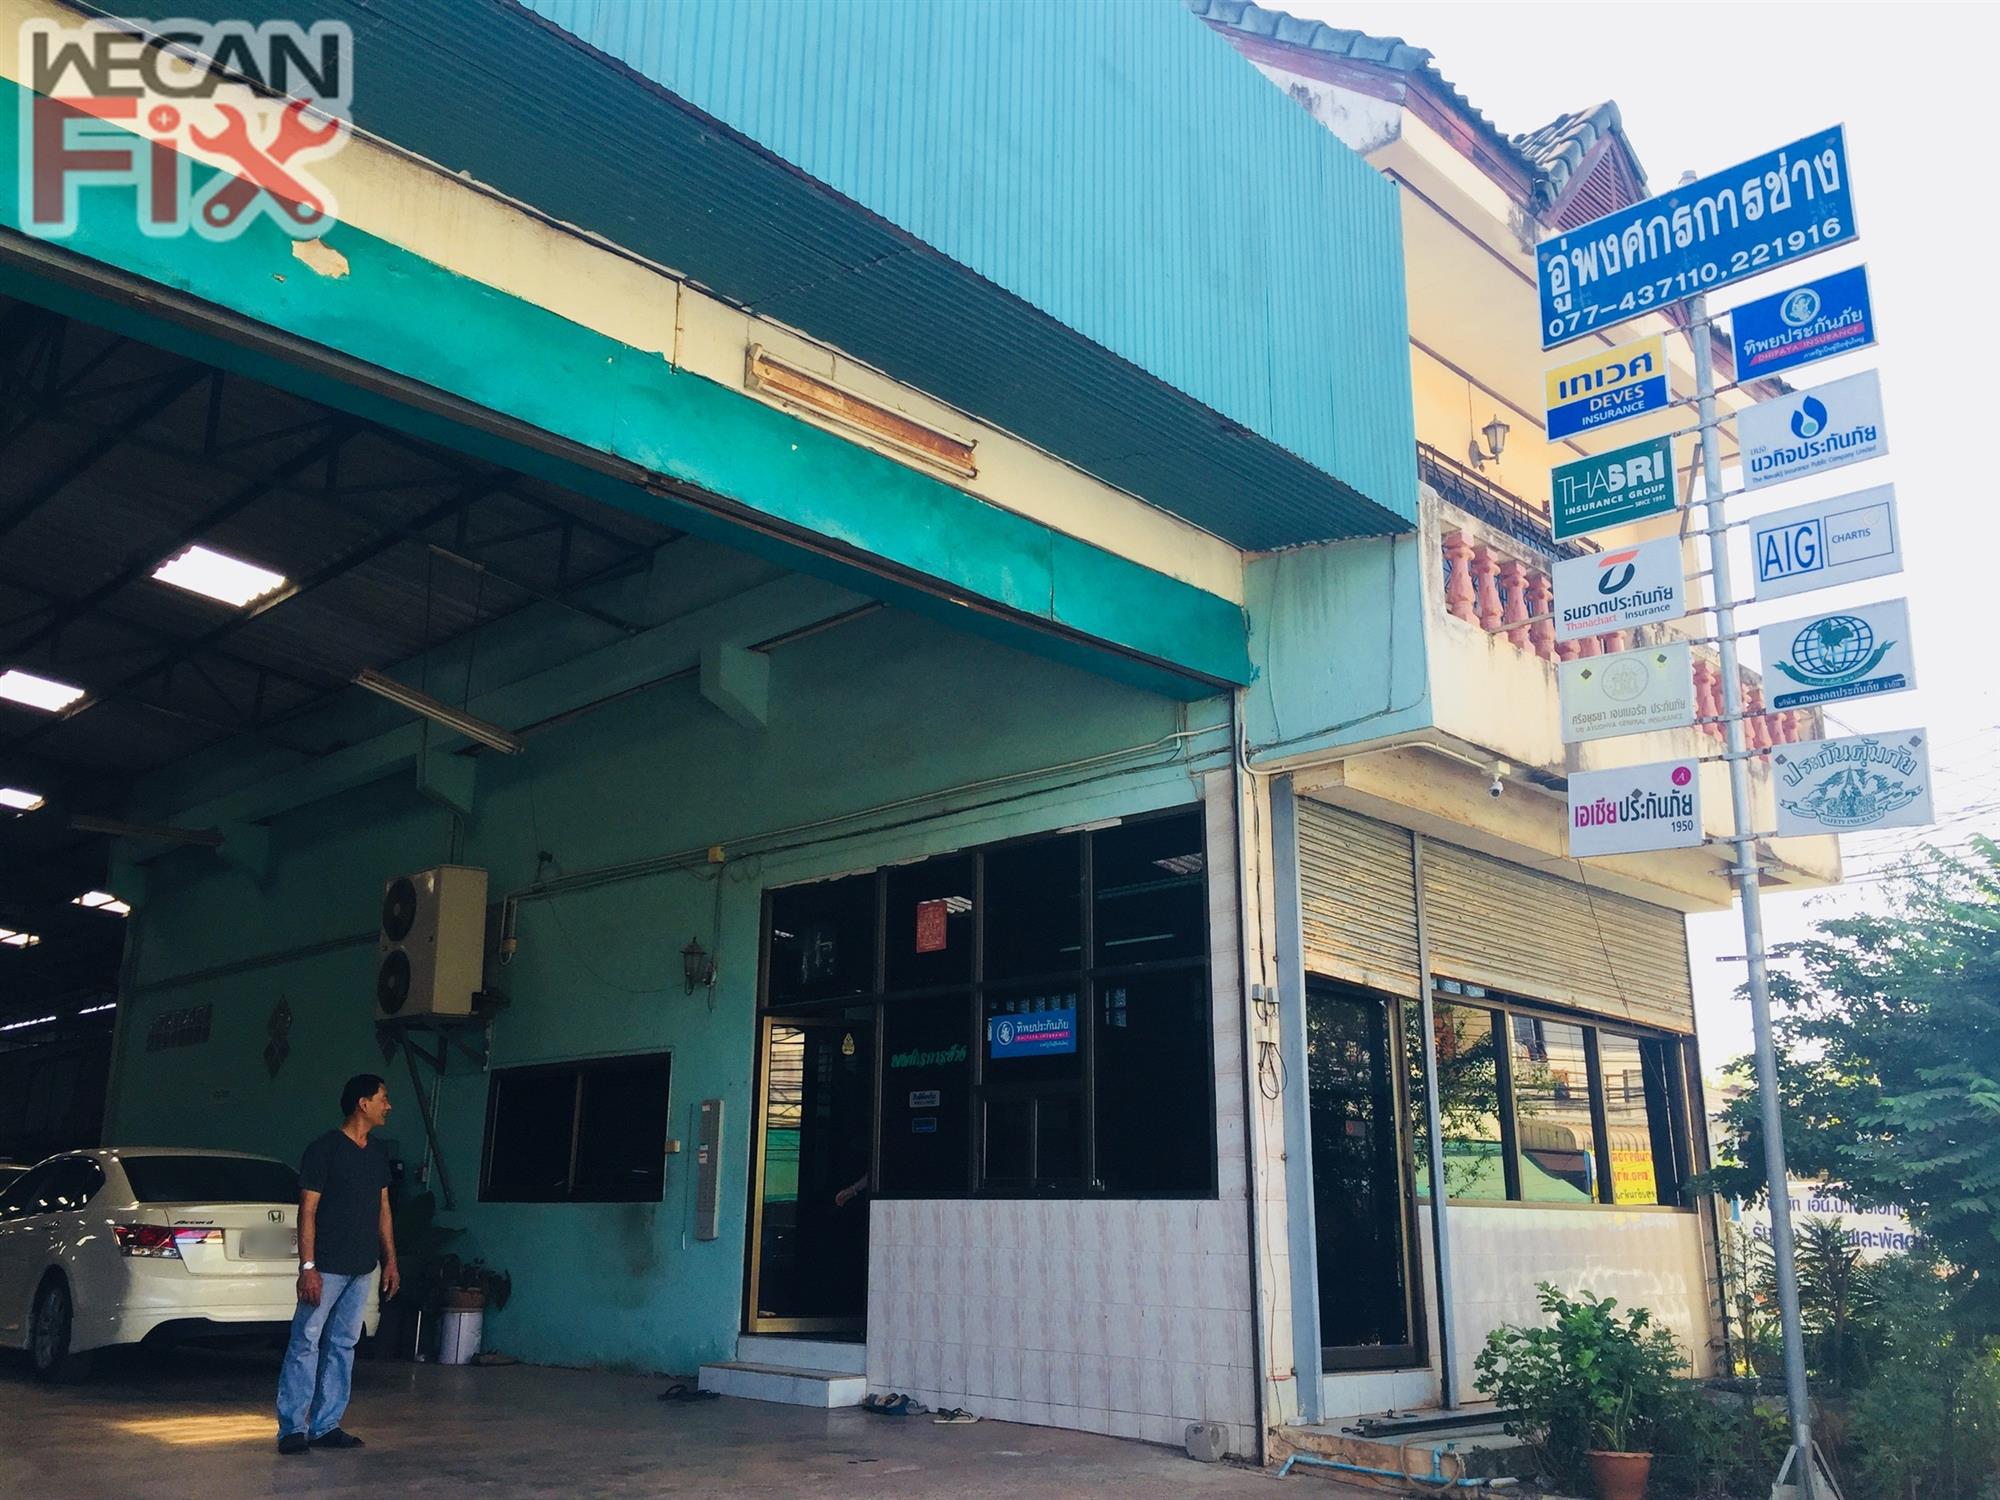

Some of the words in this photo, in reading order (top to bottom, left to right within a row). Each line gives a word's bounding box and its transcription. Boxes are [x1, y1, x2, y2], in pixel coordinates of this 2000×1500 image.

[1547, 149, 1841, 314] อู่พงศกรการช่าง
[1743, 306, 1863, 356] ทิพยประกันภัย
[1559, 352, 1653, 400] เทเวศ
[1582, 401, 1645, 425] INSURANCE
[1589, 385, 1645, 411] DEVES
[1751, 425, 1877, 473] นวกิจประกันภัย
[1565, 494, 1624, 516] INSURANCE
[1628, 484, 1665, 499] GROUP
[1764, 526, 1816, 577] AIG
[1831, 528, 1871, 544] CHARTIS
[1563, 586, 1674, 622] ธนชาตประกันภัย
[1566, 614, 1617, 631] Thanachart
[1624, 603, 1671, 620] Insurance
[1782, 738, 1918, 788] ประกันคุ้มภัย
[1671, 819, 1693, 833] 1950
